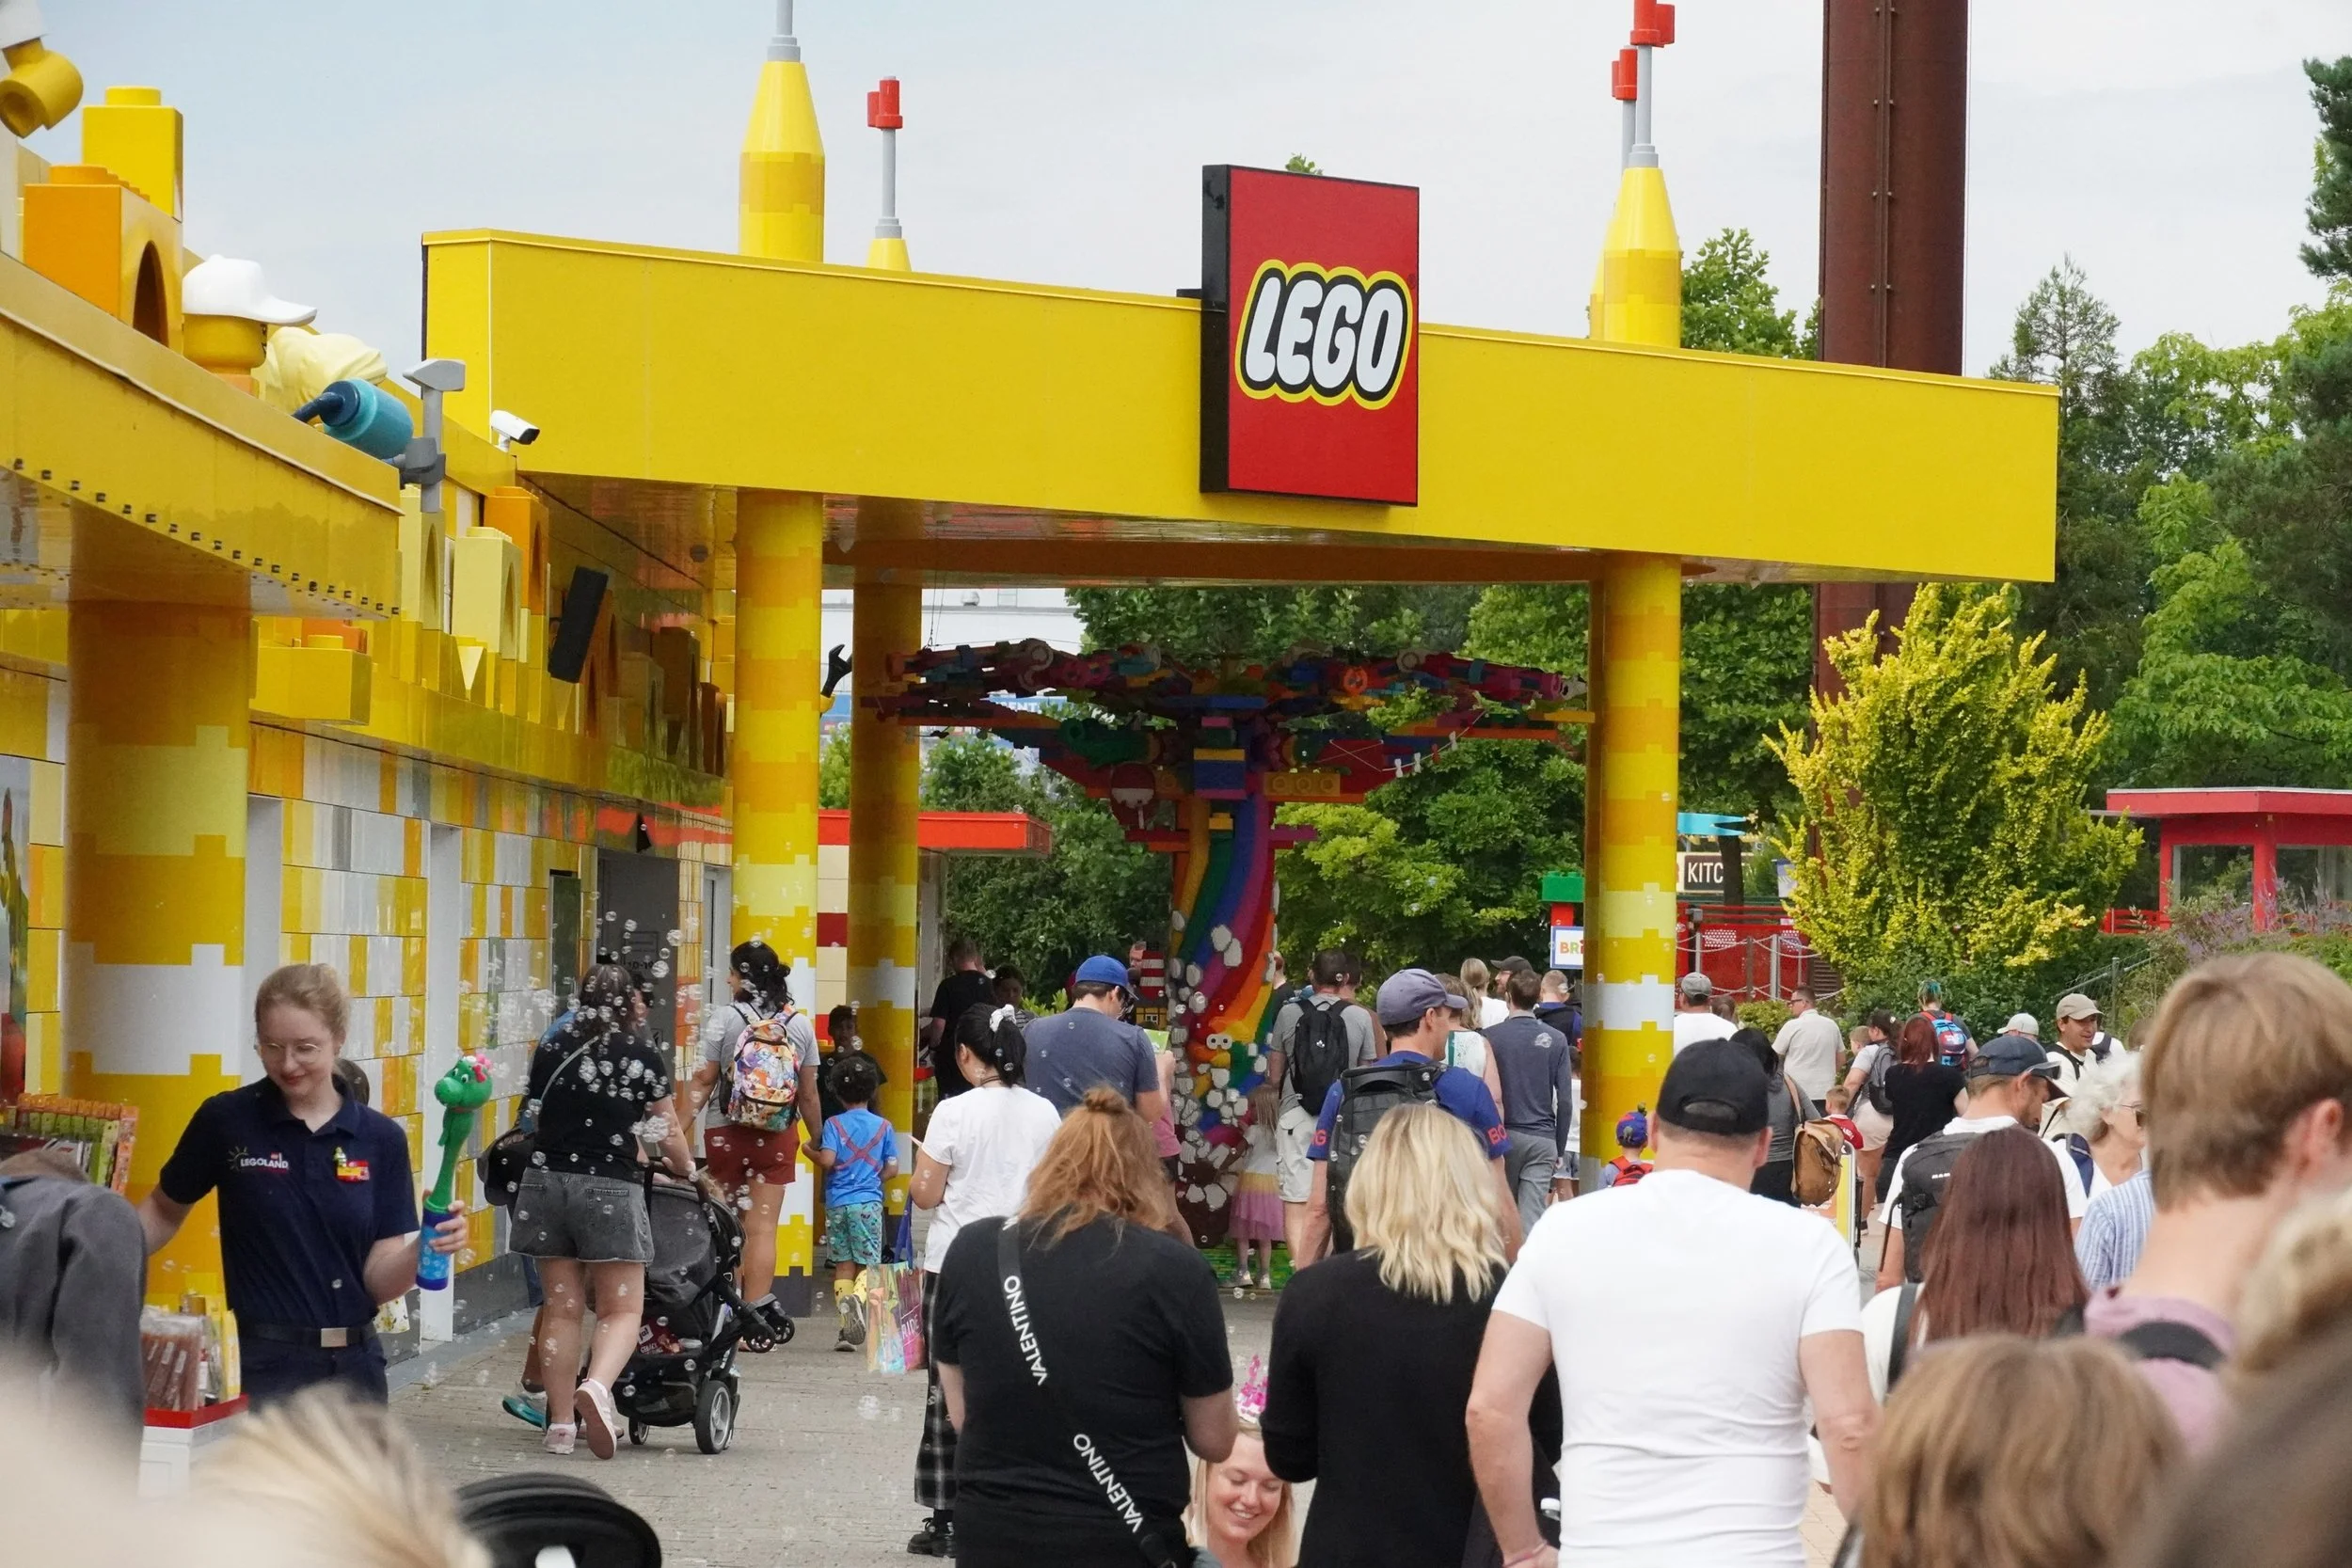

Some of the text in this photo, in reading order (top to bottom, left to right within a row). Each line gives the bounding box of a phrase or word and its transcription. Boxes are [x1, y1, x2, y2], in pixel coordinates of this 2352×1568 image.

[1243, 271, 1407, 399] LEGO
[1687, 862, 1724, 884] KITC
[240, 1152, 289, 1169] LEGOLAND
[1487, 1124, 1507, 1145] BO
[1003, 1275, 1048, 1386] VALENTINO
[1073, 1433, 1144, 1533] VALENTINO
